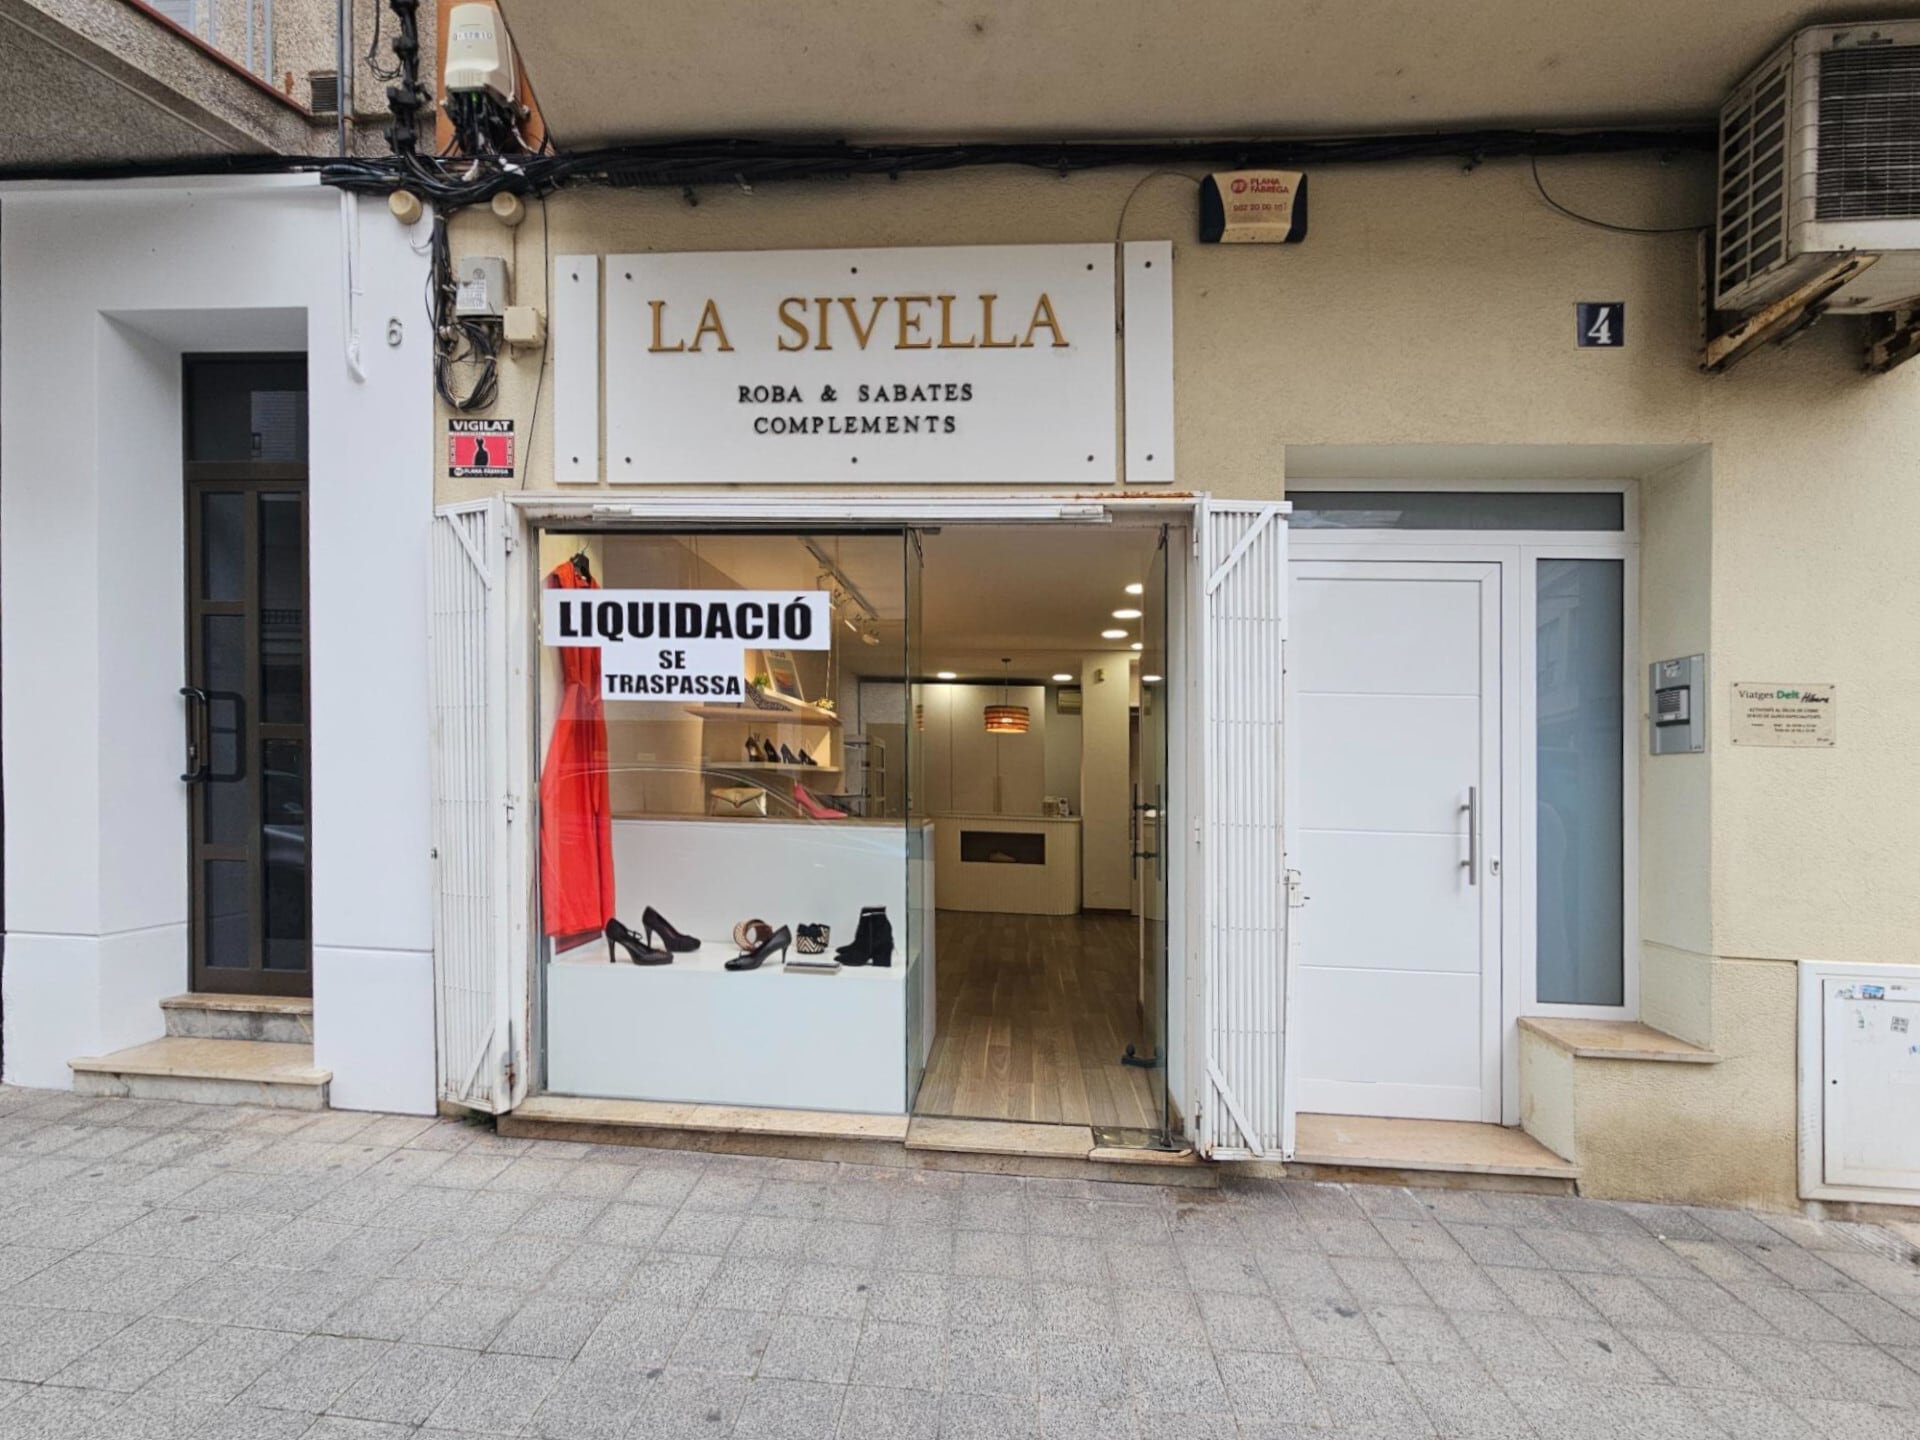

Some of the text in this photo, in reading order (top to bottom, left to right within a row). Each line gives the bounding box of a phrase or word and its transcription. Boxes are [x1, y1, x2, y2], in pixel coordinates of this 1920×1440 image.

[388, 317, 402, 348] 6
[648, 292, 1070, 353] LA SIVELLA
[1588, 307, 1611, 344] 4
[738, 383, 974, 404] ROBA & SABATES
[452, 420, 510, 431] VIGILAT
[753, 415, 957, 435] COMPLEMENTS
[560, 597, 812, 642] LIQUIDACIÓ
[658, 650, 686, 669] SE
[605, 674, 741, 695] TRASPASSA
[1739, 690, 1774, 701] Viatges
